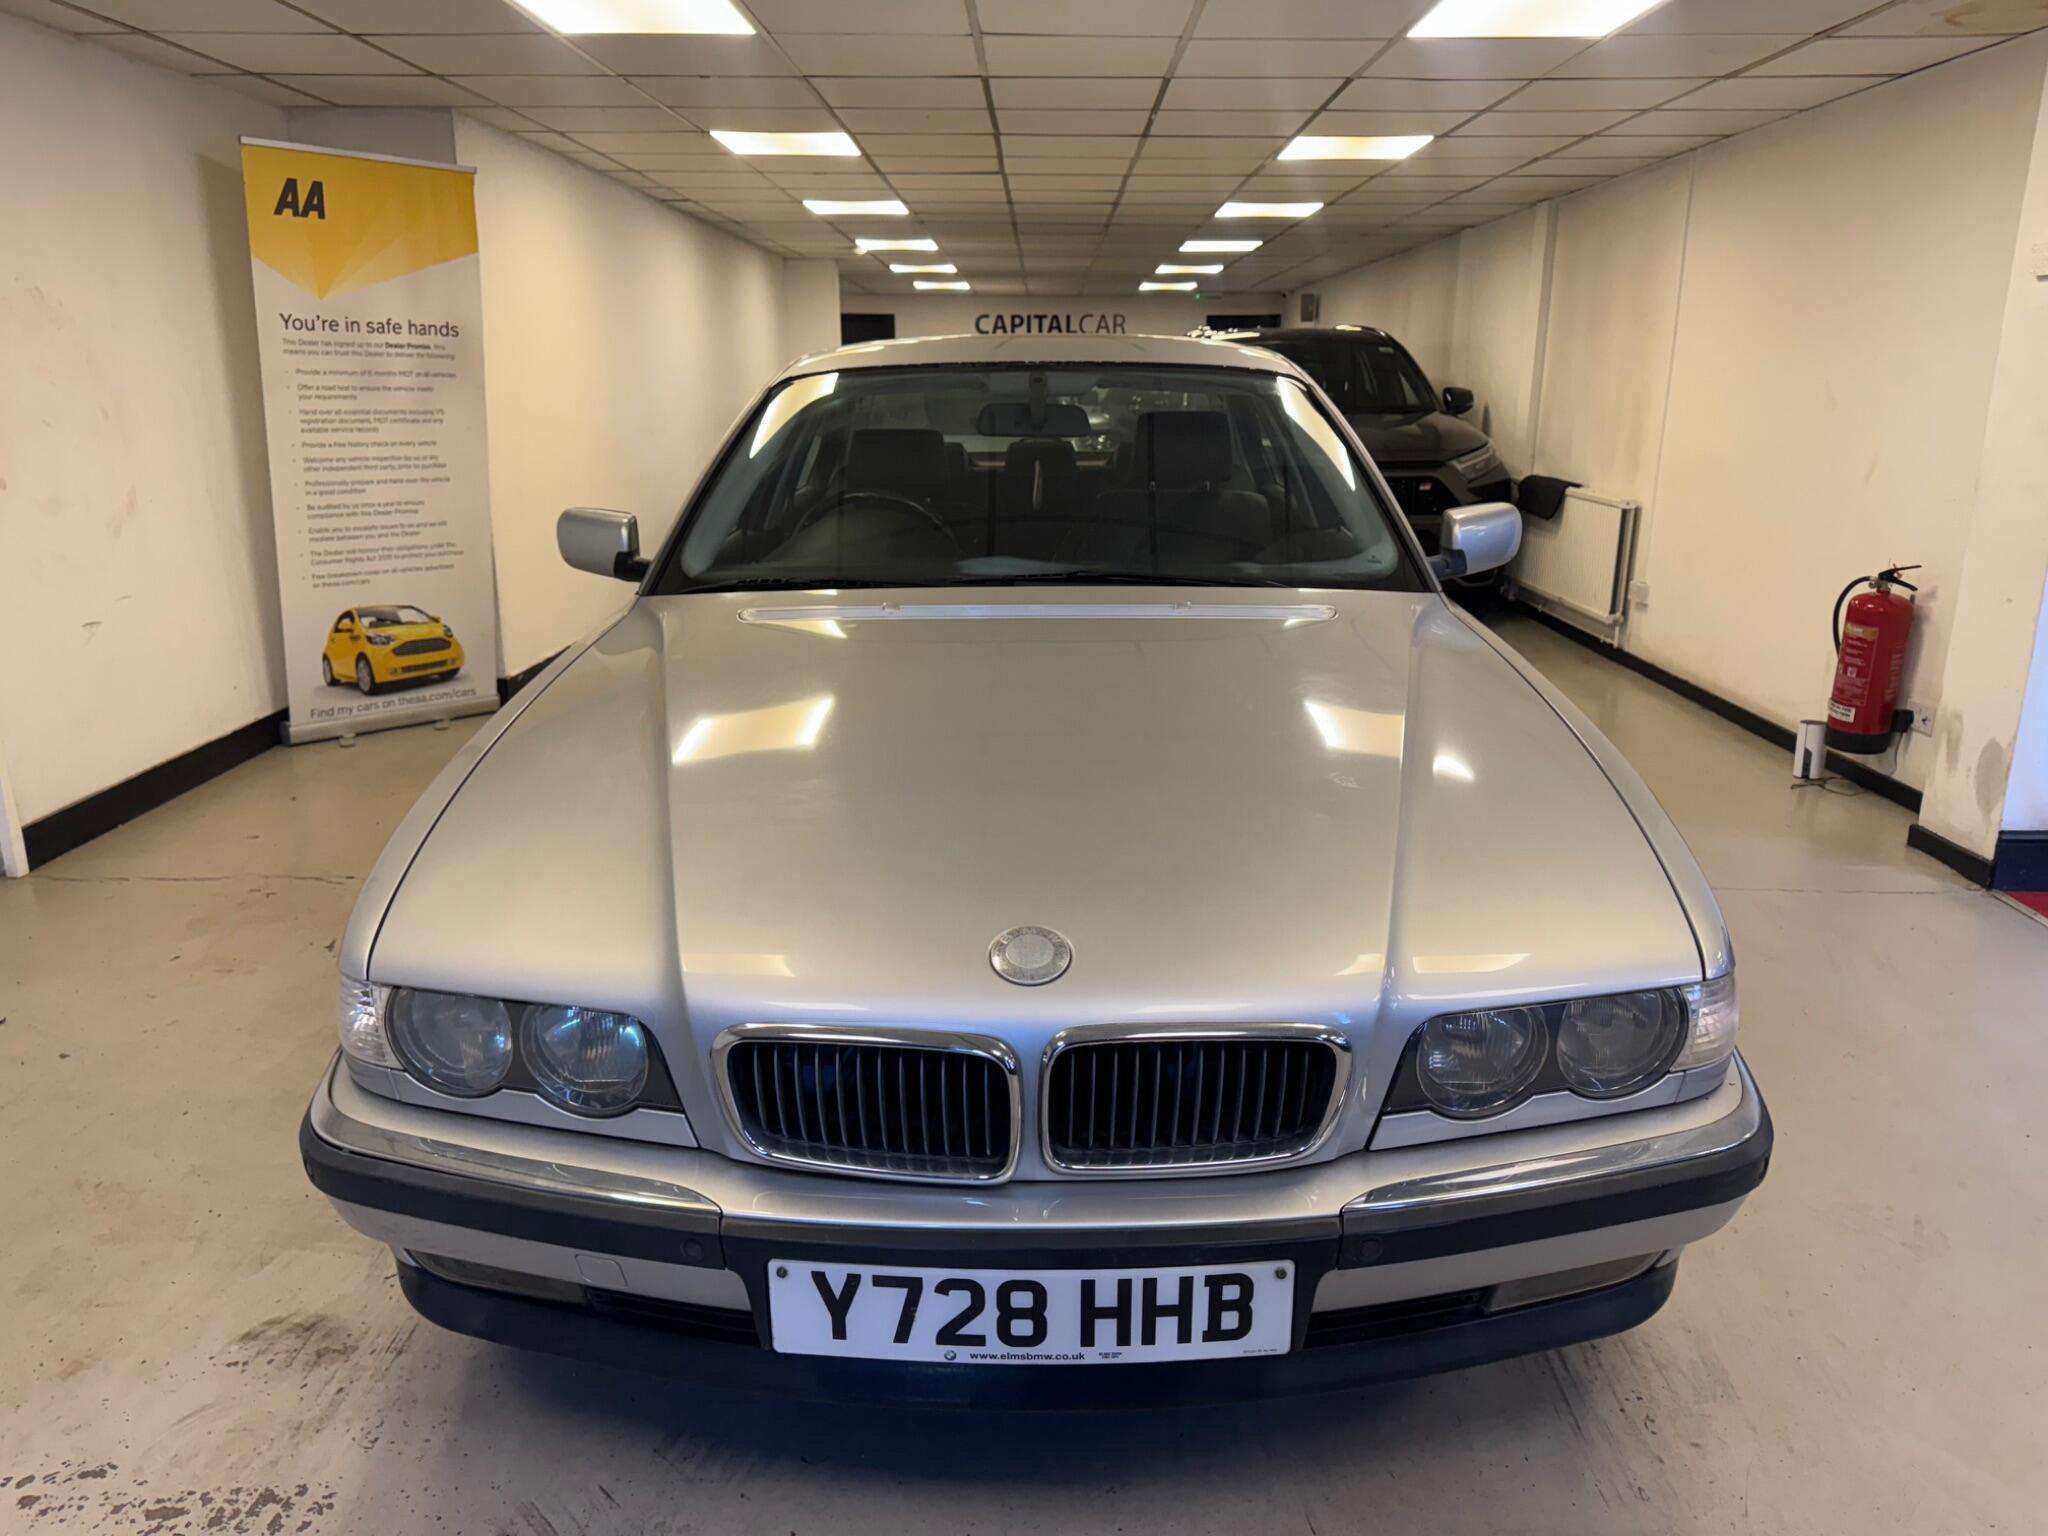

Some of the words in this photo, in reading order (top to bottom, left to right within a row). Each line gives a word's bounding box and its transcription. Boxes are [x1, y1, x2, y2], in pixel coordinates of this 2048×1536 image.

[273, 178, 326, 219] AA
[345, 316, 361, 333] in
[366, 317, 403, 335] safe
[408, 319, 460, 337] hands
[310, 706, 335, 719] Find
[337, 705, 353, 717] my
[357, 702, 380, 713] cars
[382, 699, 395, 709] on
[811, 1270, 1048, 1348] Y728
[1080, 1273, 1254, 1348] HHB
[969, 1351, 1086, 1361] www.elmsbmw.co.uk
